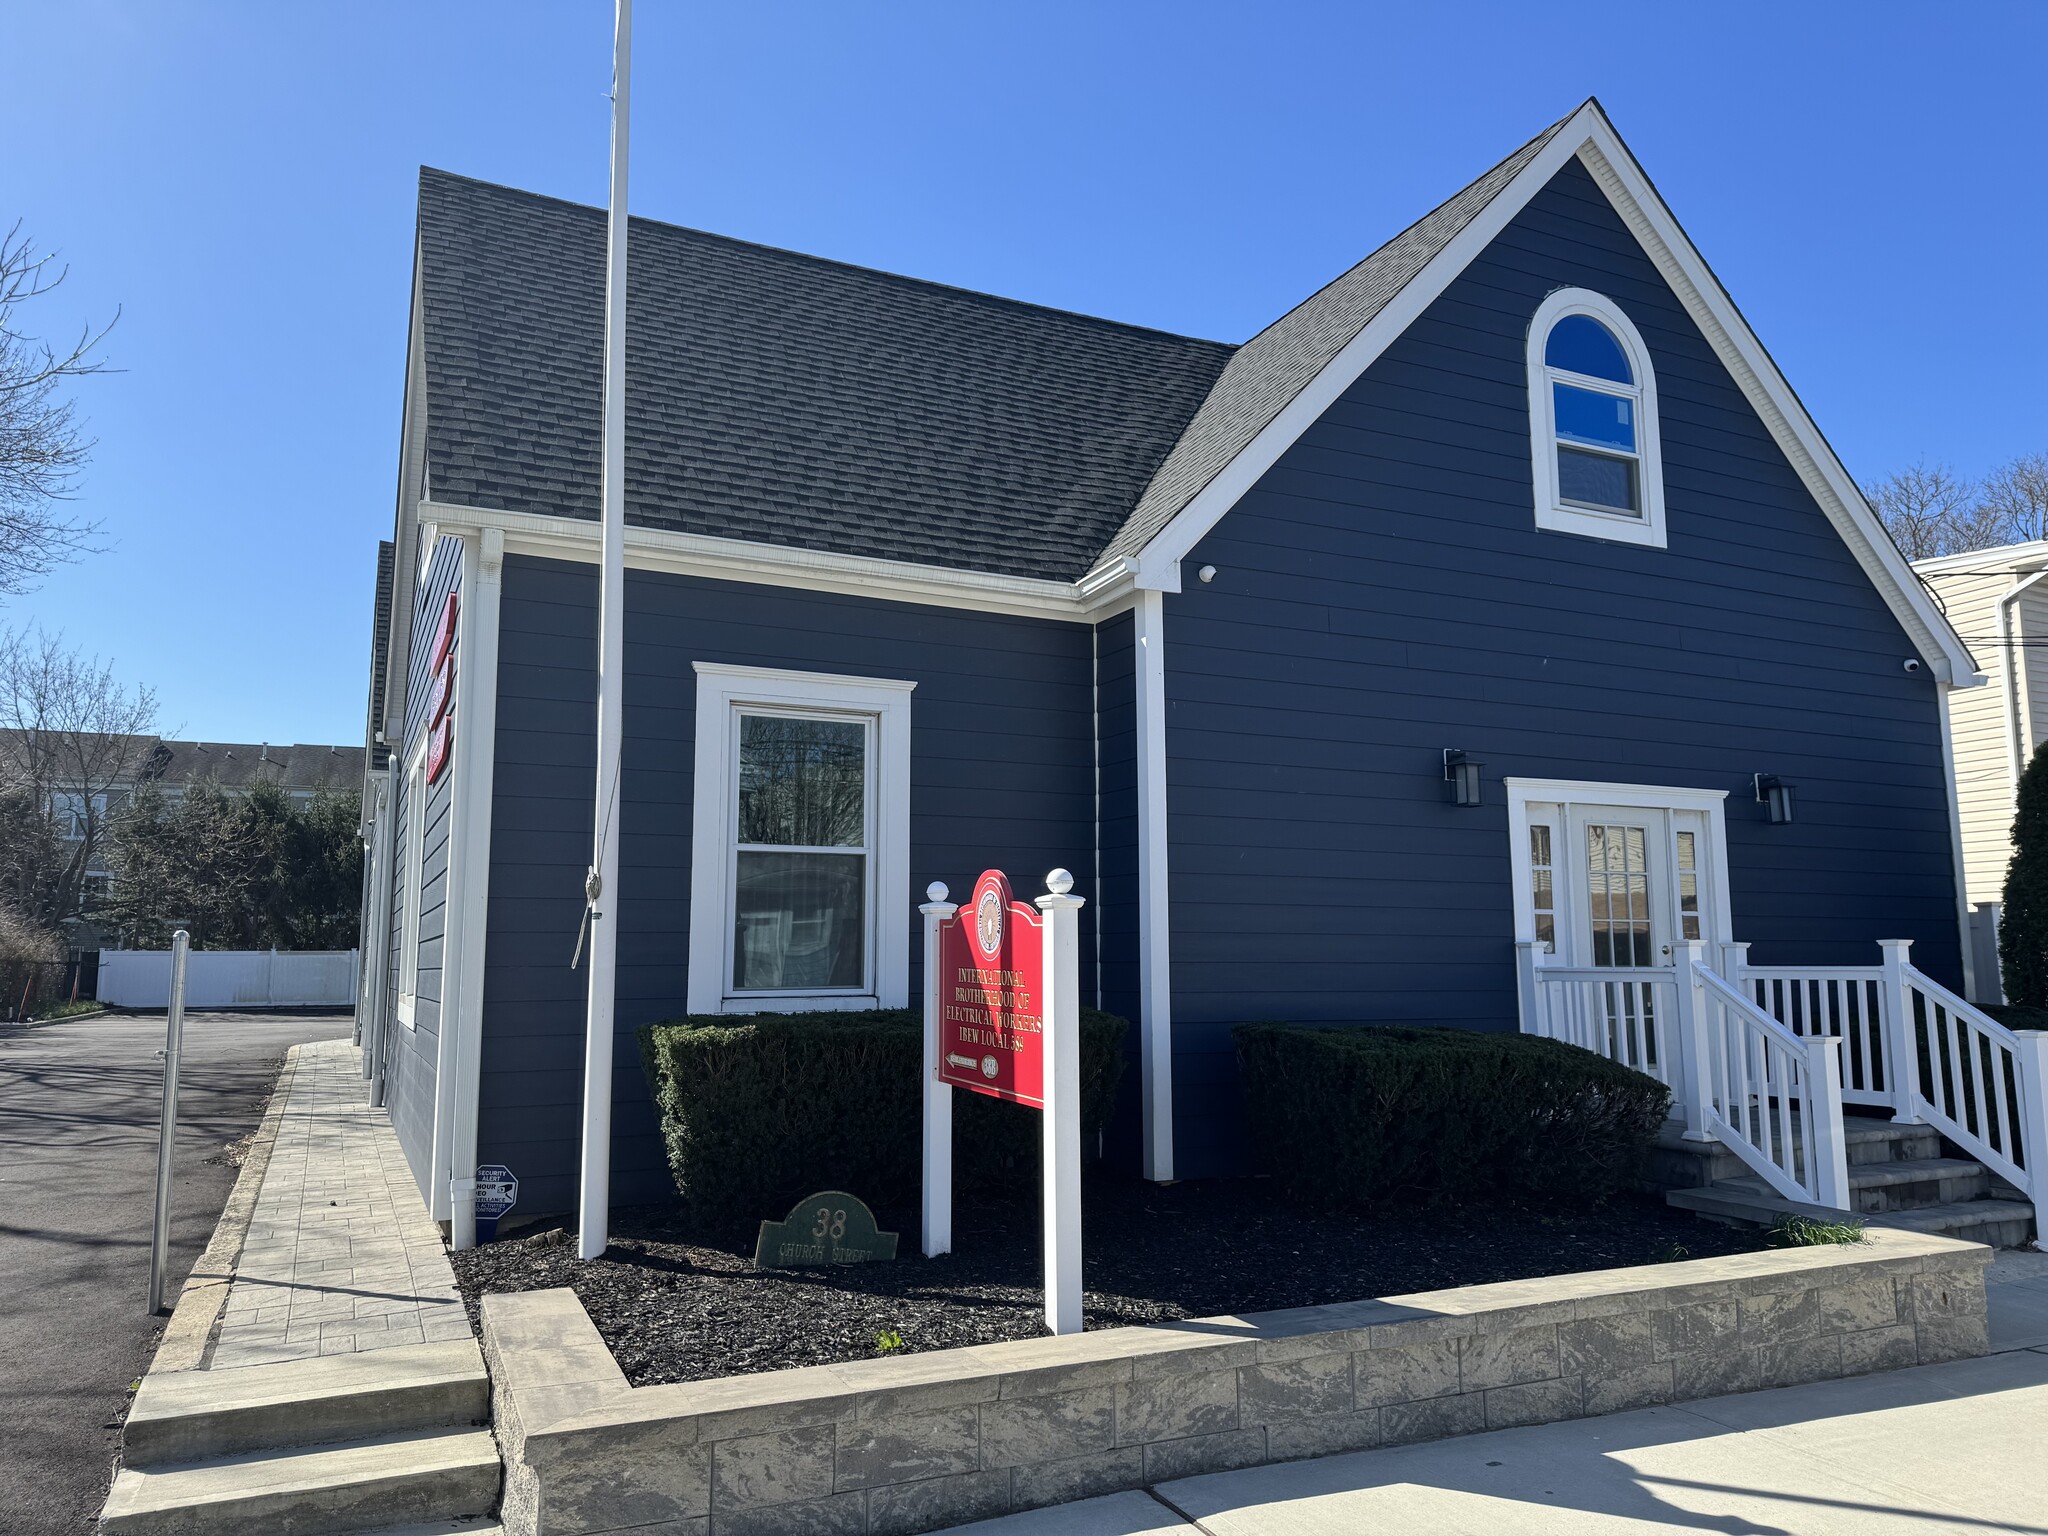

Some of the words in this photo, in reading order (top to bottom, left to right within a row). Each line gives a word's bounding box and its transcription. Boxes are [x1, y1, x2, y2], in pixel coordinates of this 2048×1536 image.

[958, 967, 1025, 988] INTERNATIONAL
[955, 986, 1016, 1008] BROTHERHOOD
[1017, 992, 1030, 1010] OF
[946, 1005, 994, 1026] ELECTRICAL
[995, 1011, 1042, 1033] WORKERS
[959, 1026, 979, 1043] IBEW
[981, 1029, 1010, 1050] LOCAL
[812, 1207, 847, 1240] 38
[779, 1242, 825, 1260] CHURCH
[831, 1247, 873, 1264] STREET
